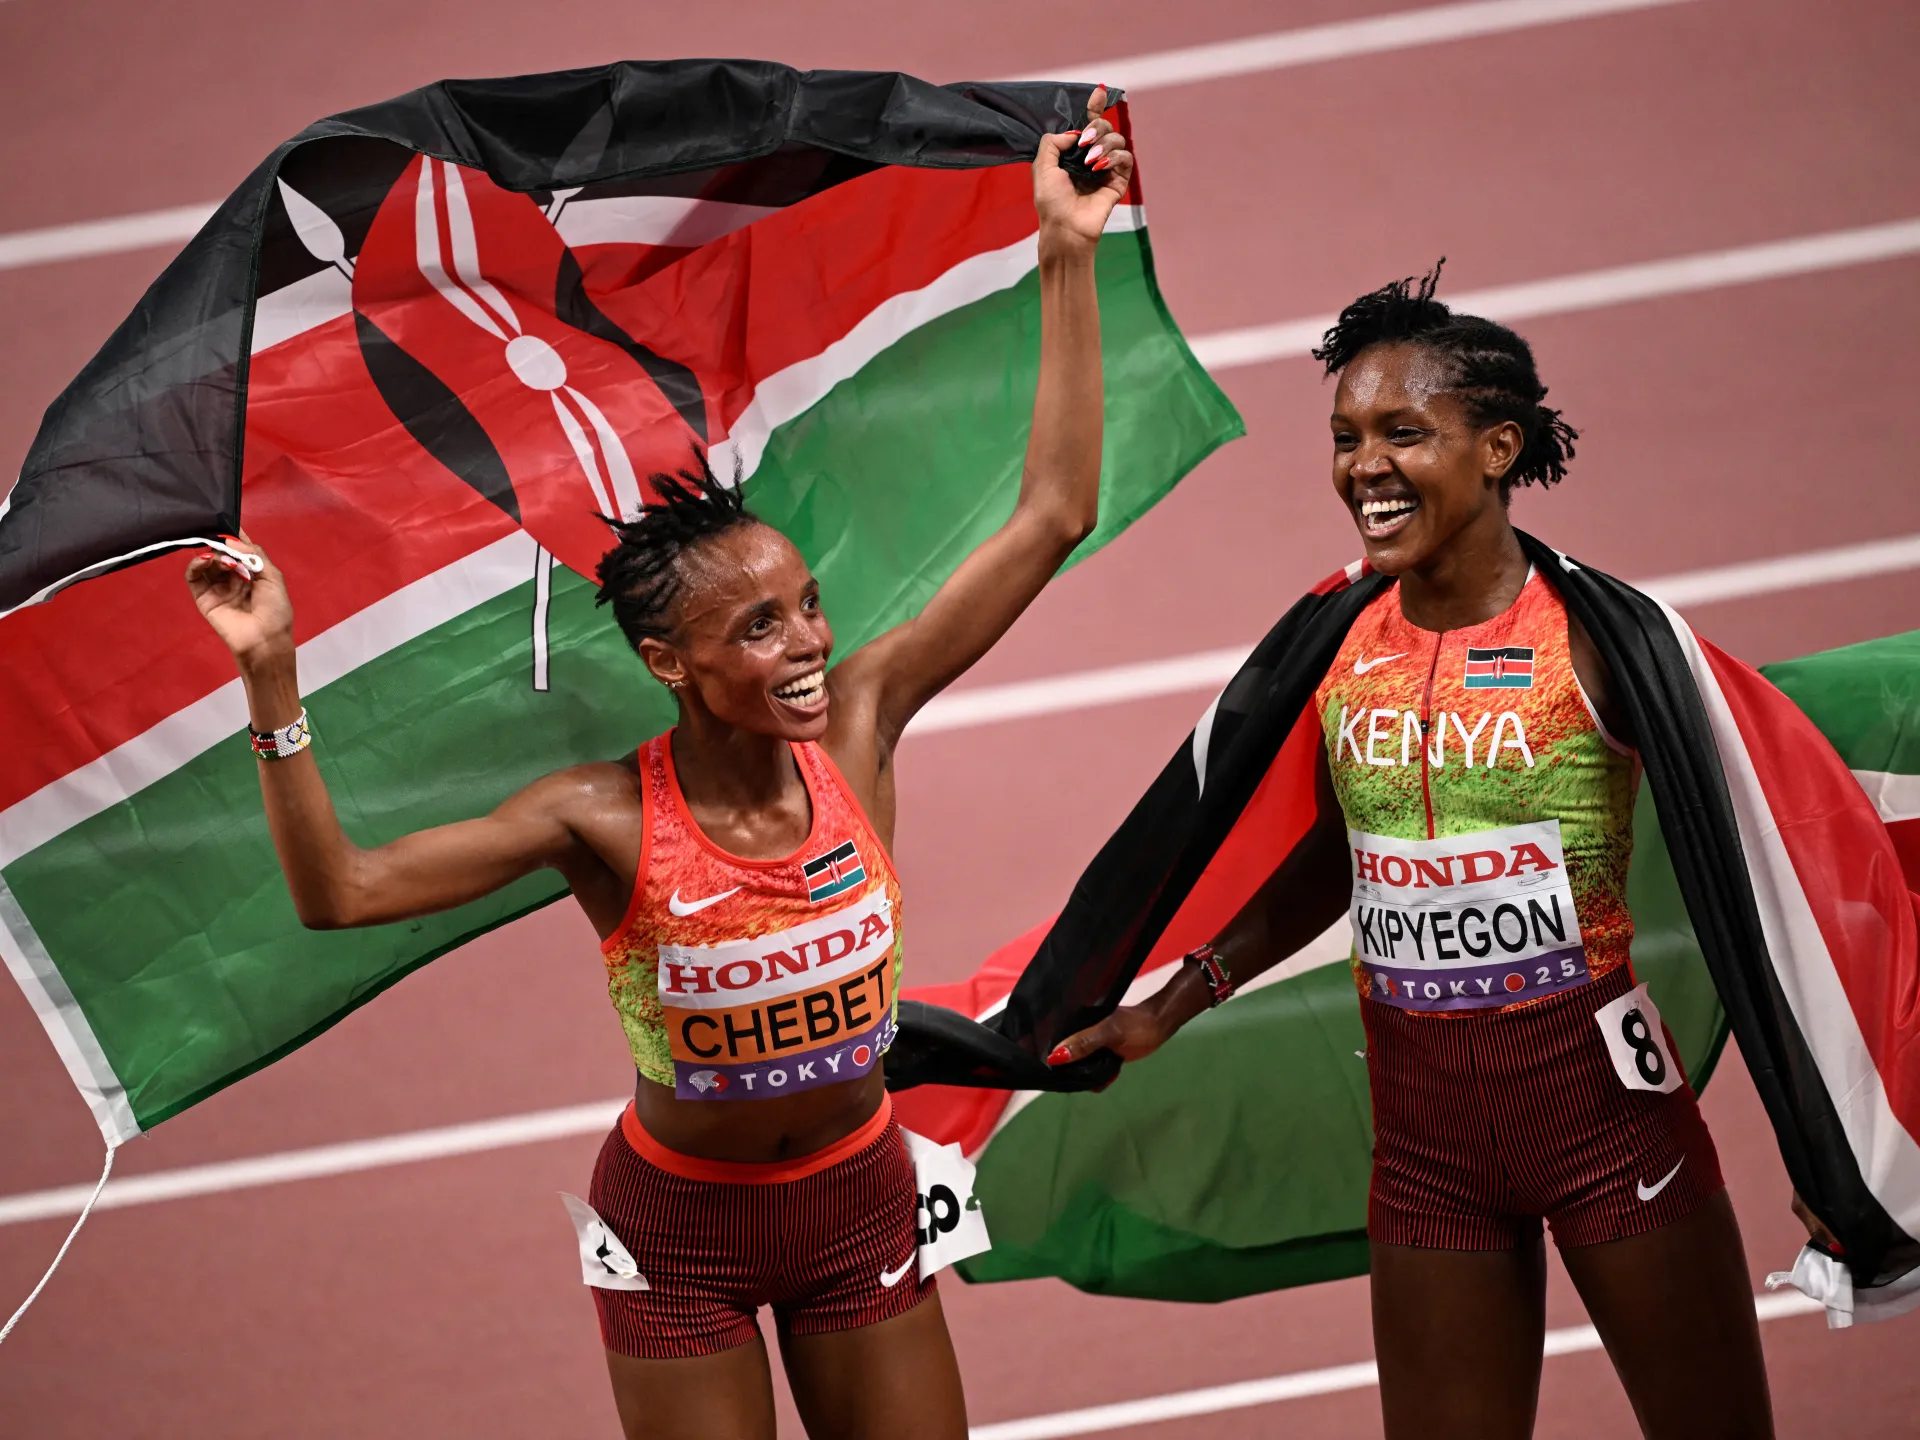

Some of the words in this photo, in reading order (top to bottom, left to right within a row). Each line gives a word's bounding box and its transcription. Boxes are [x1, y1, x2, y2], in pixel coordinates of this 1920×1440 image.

[1336, 705, 1535, 769] KENYA
[1354, 842, 1559, 888] HONDA
[665, 913, 890, 994] HONDA
[1357, 894, 1567, 961] KIPYEGON
[1535, 957, 1576, 985] 25
[681, 957, 888, 1059] CHEBET
[1621, 1008, 1666, 1086] 8
